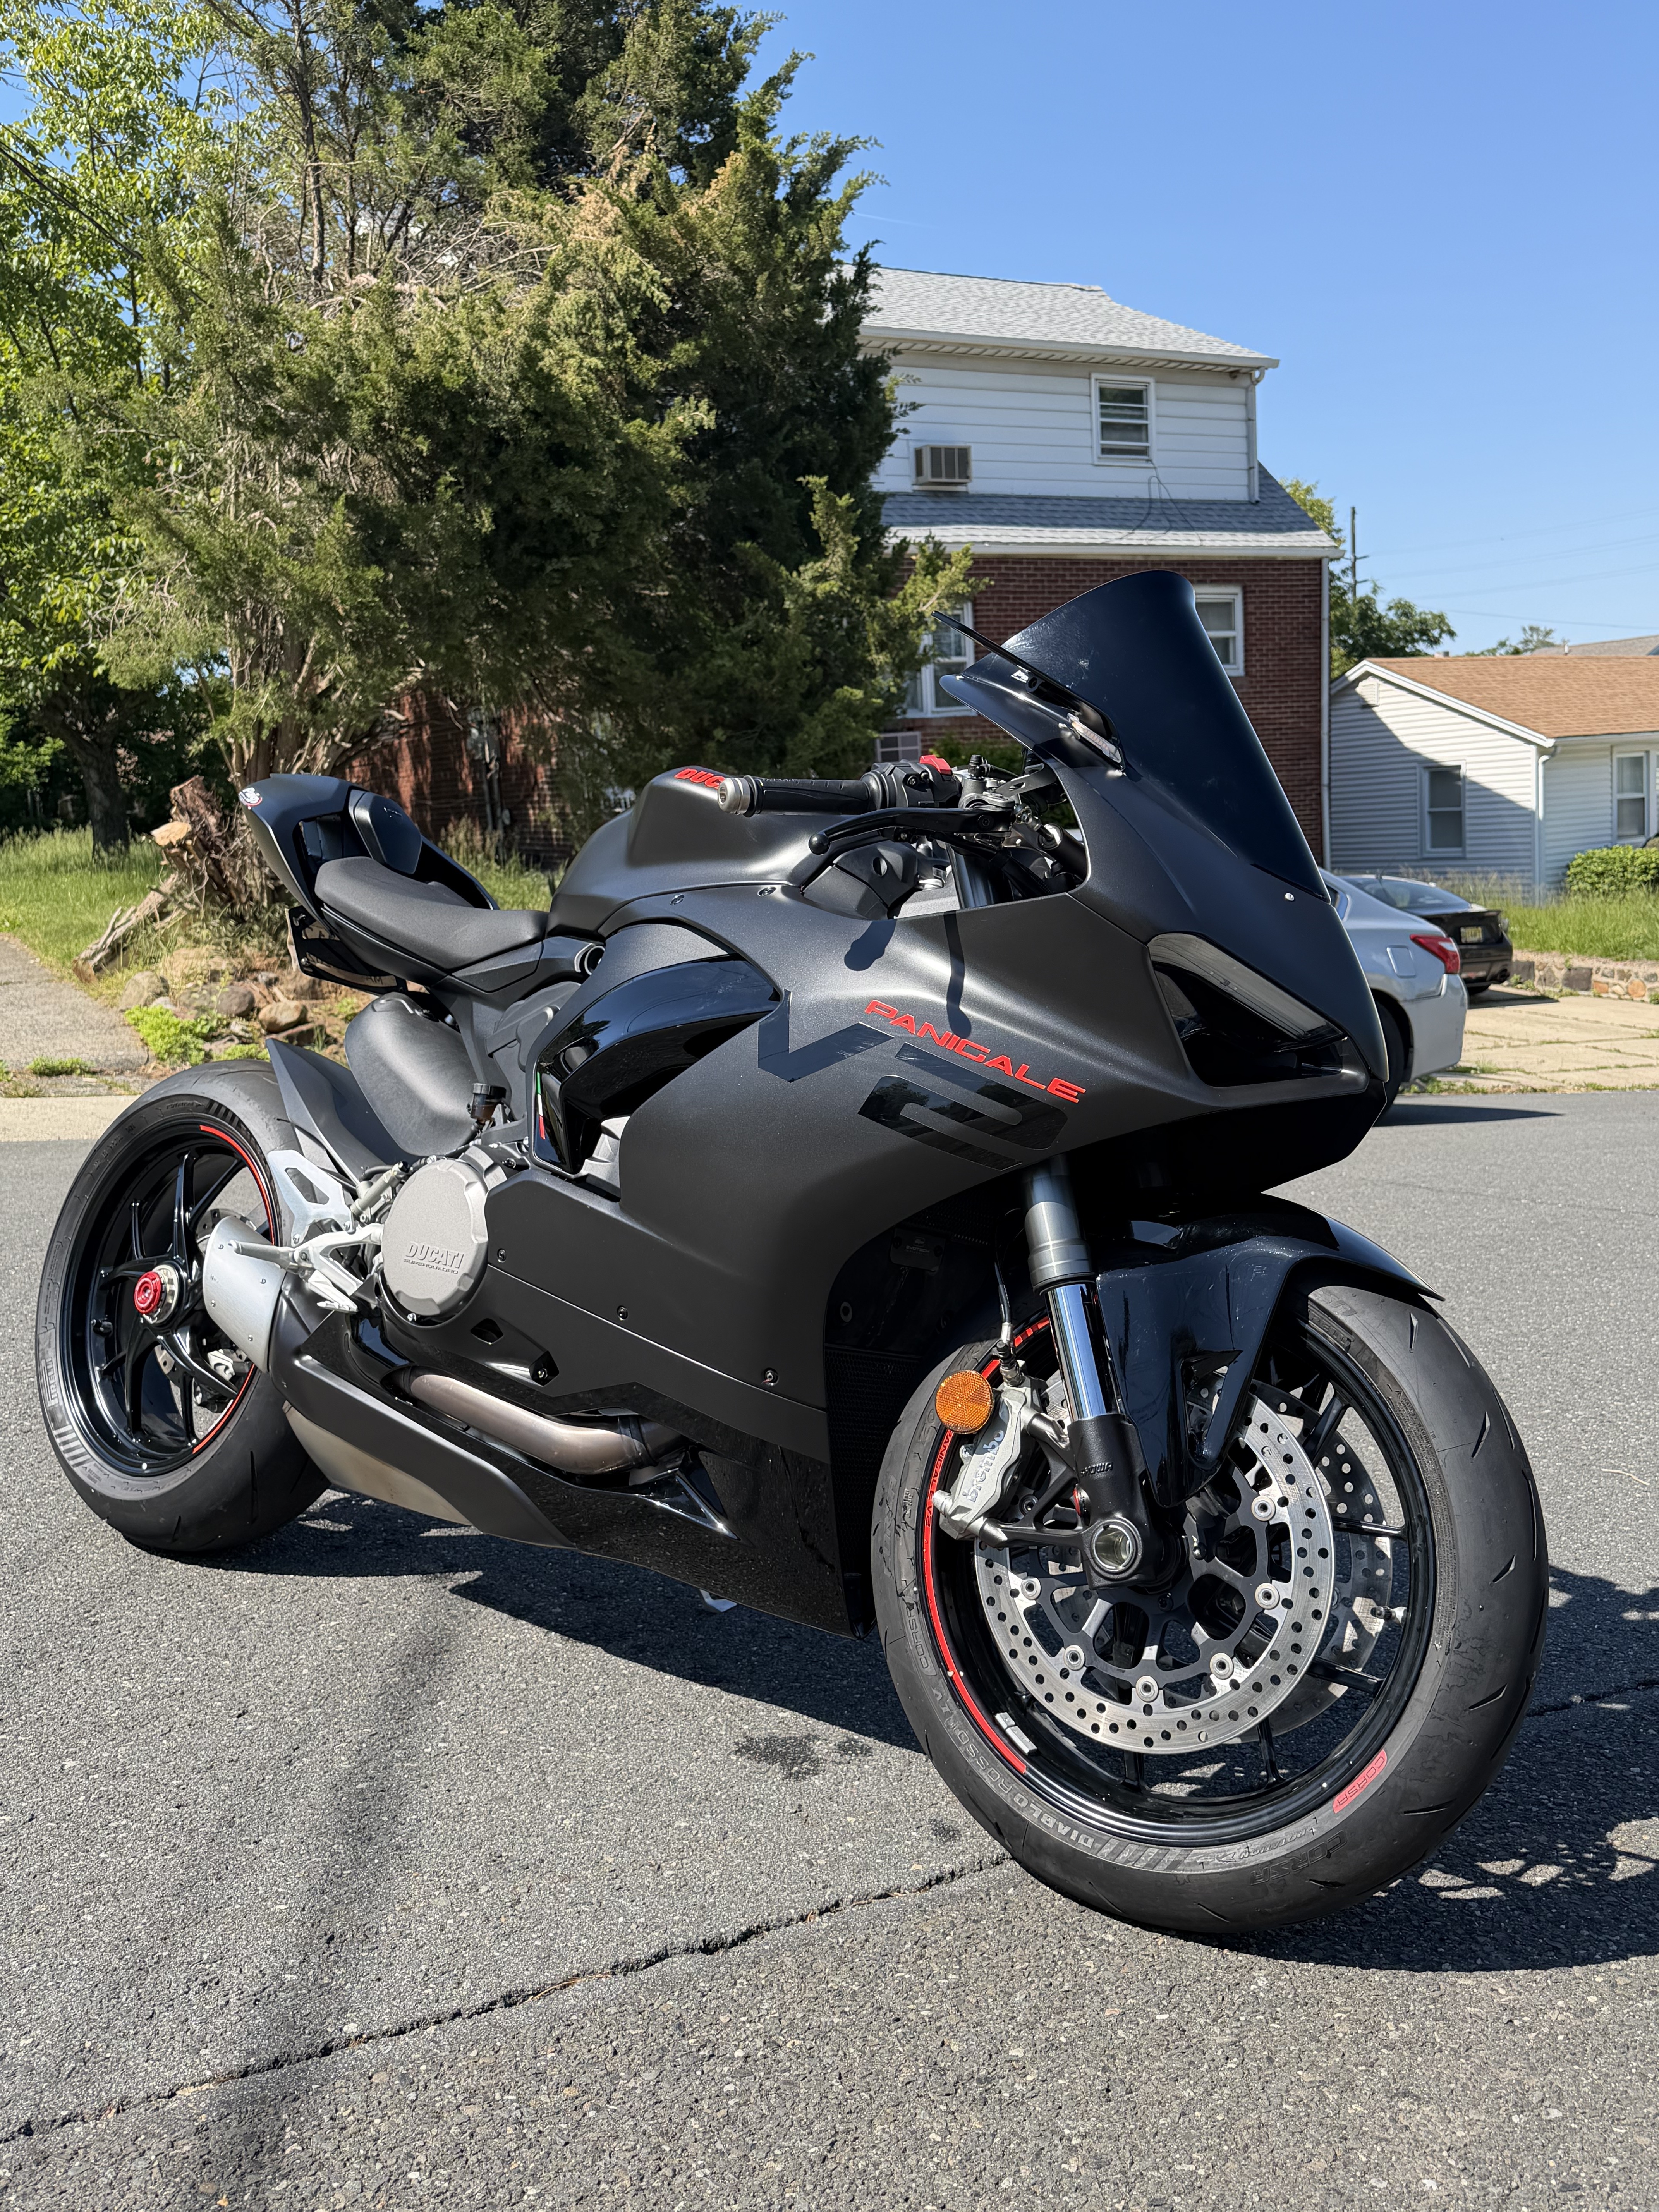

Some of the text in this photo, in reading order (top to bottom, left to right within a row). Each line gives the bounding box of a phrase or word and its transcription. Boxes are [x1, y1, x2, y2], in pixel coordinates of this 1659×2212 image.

[674, 768, 726, 789] DUC
[757, 989, 1068, 1171] V2
[864, 999, 1086, 1104] PANIGALE
[405, 1241, 464, 1269] DUCATI
[41, 1357, 59, 1407] PIRELLI
[962, 1429, 1005, 1503] brembo
[957, 1730, 1013, 1794] ROSSO
[1337, 1756, 1385, 1806] CORSA
[1014, 1792, 1095, 1849] DIABLO
[1250, 1829, 1348, 1886] CORSA
